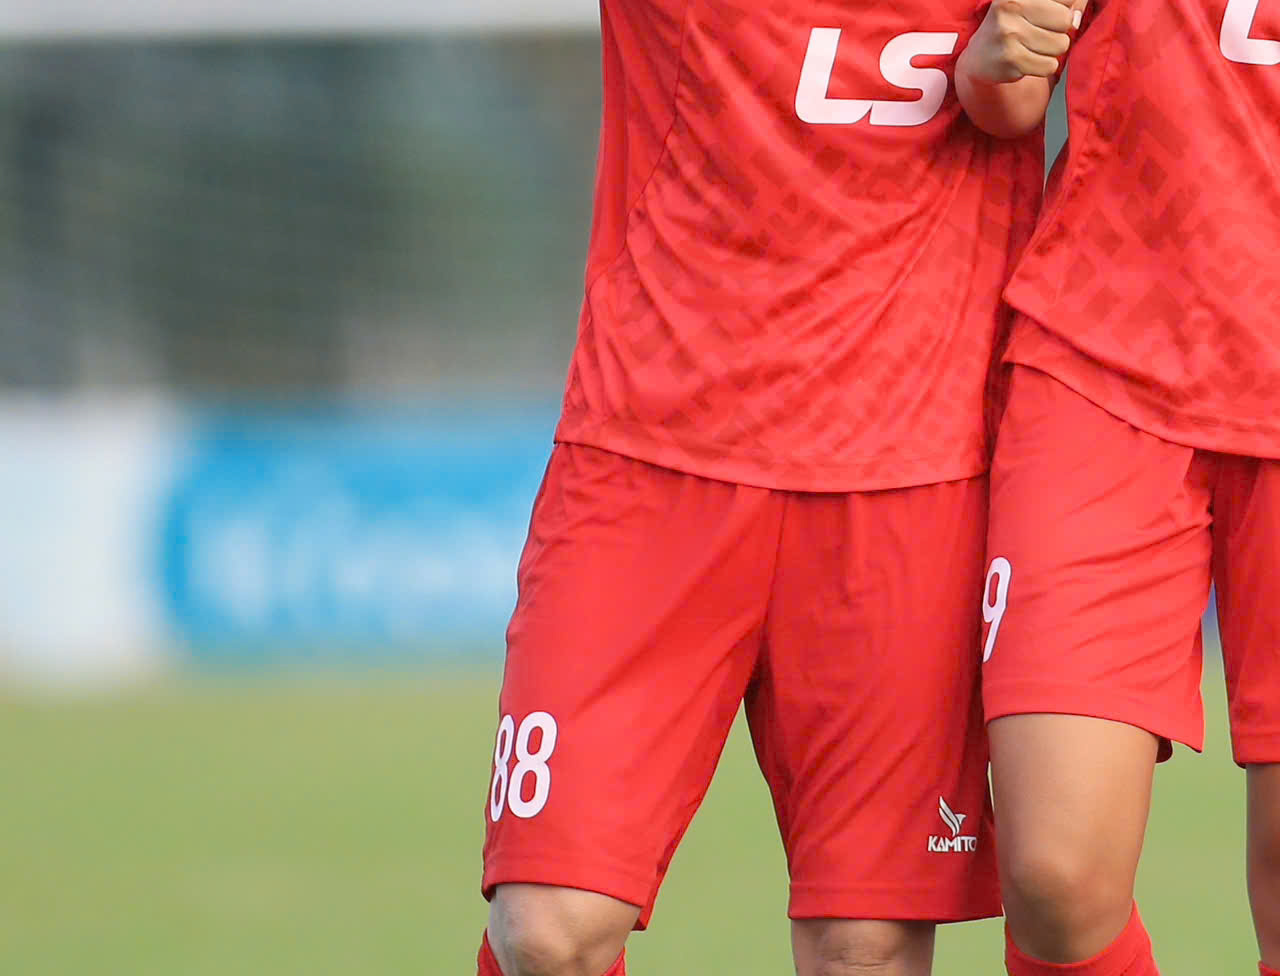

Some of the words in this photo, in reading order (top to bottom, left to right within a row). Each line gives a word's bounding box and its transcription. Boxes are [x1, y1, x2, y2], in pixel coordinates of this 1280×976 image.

[795, 27, 959, 127] LS
[983, 556, 1012, 663] 9
[490, 711, 558, 822] 88
